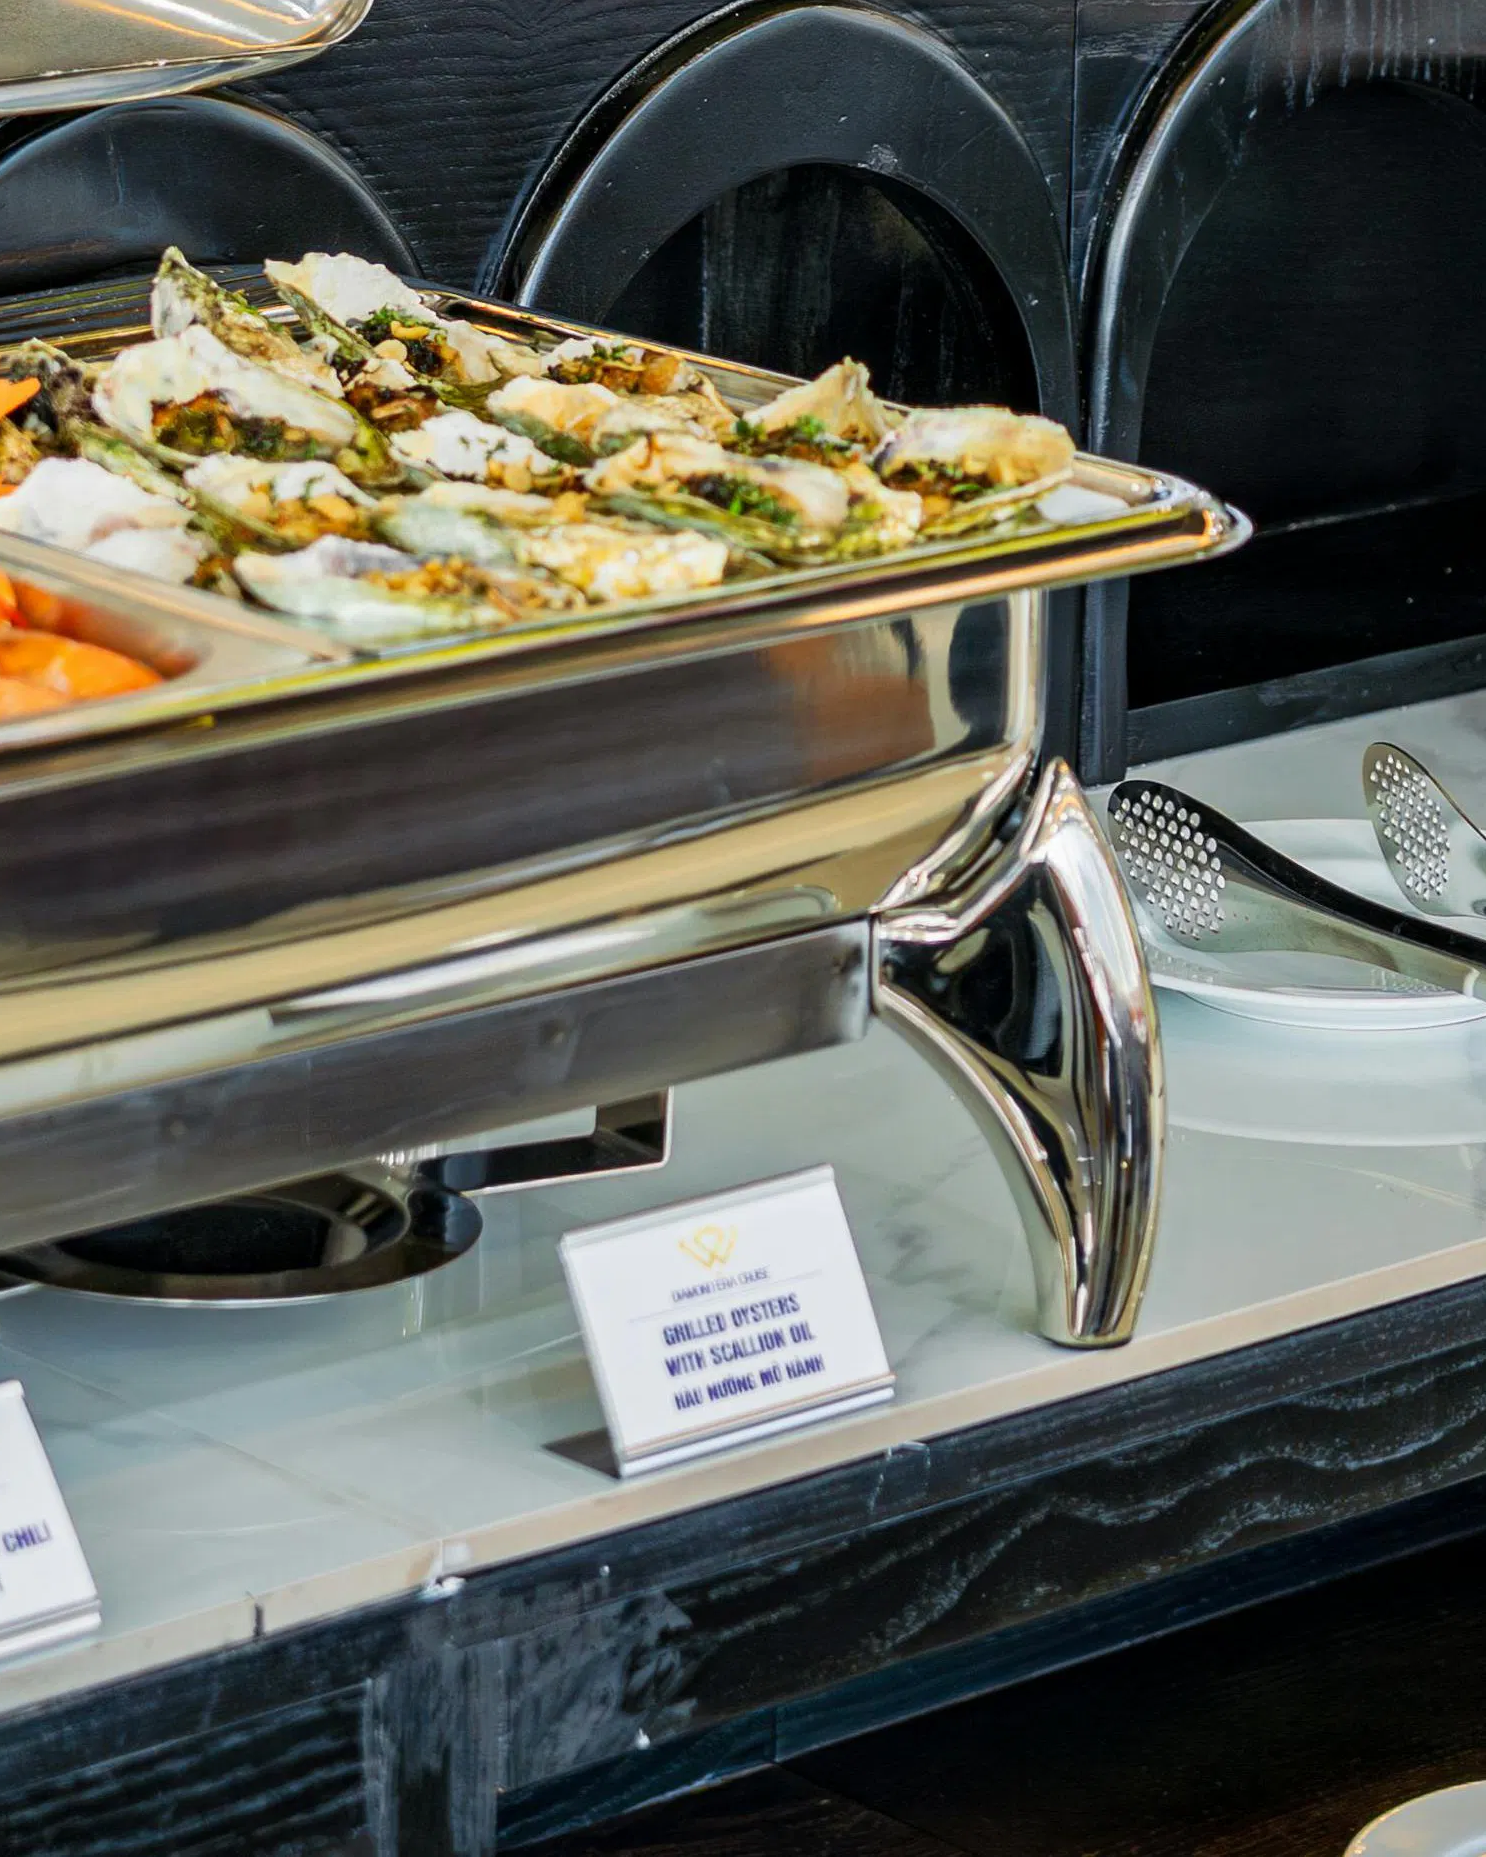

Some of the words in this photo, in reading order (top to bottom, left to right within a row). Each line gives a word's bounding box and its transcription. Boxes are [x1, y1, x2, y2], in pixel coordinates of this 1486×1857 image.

[663, 1312, 727, 1346] GRILLED
[731, 1293, 801, 1327] OYSTERS
[665, 1348, 707, 1377] WITH
[710, 1327, 787, 1365] SCALLION
[790, 1320, 816, 1343] OIL
[3, 1520, 53, 1553] CHILI
